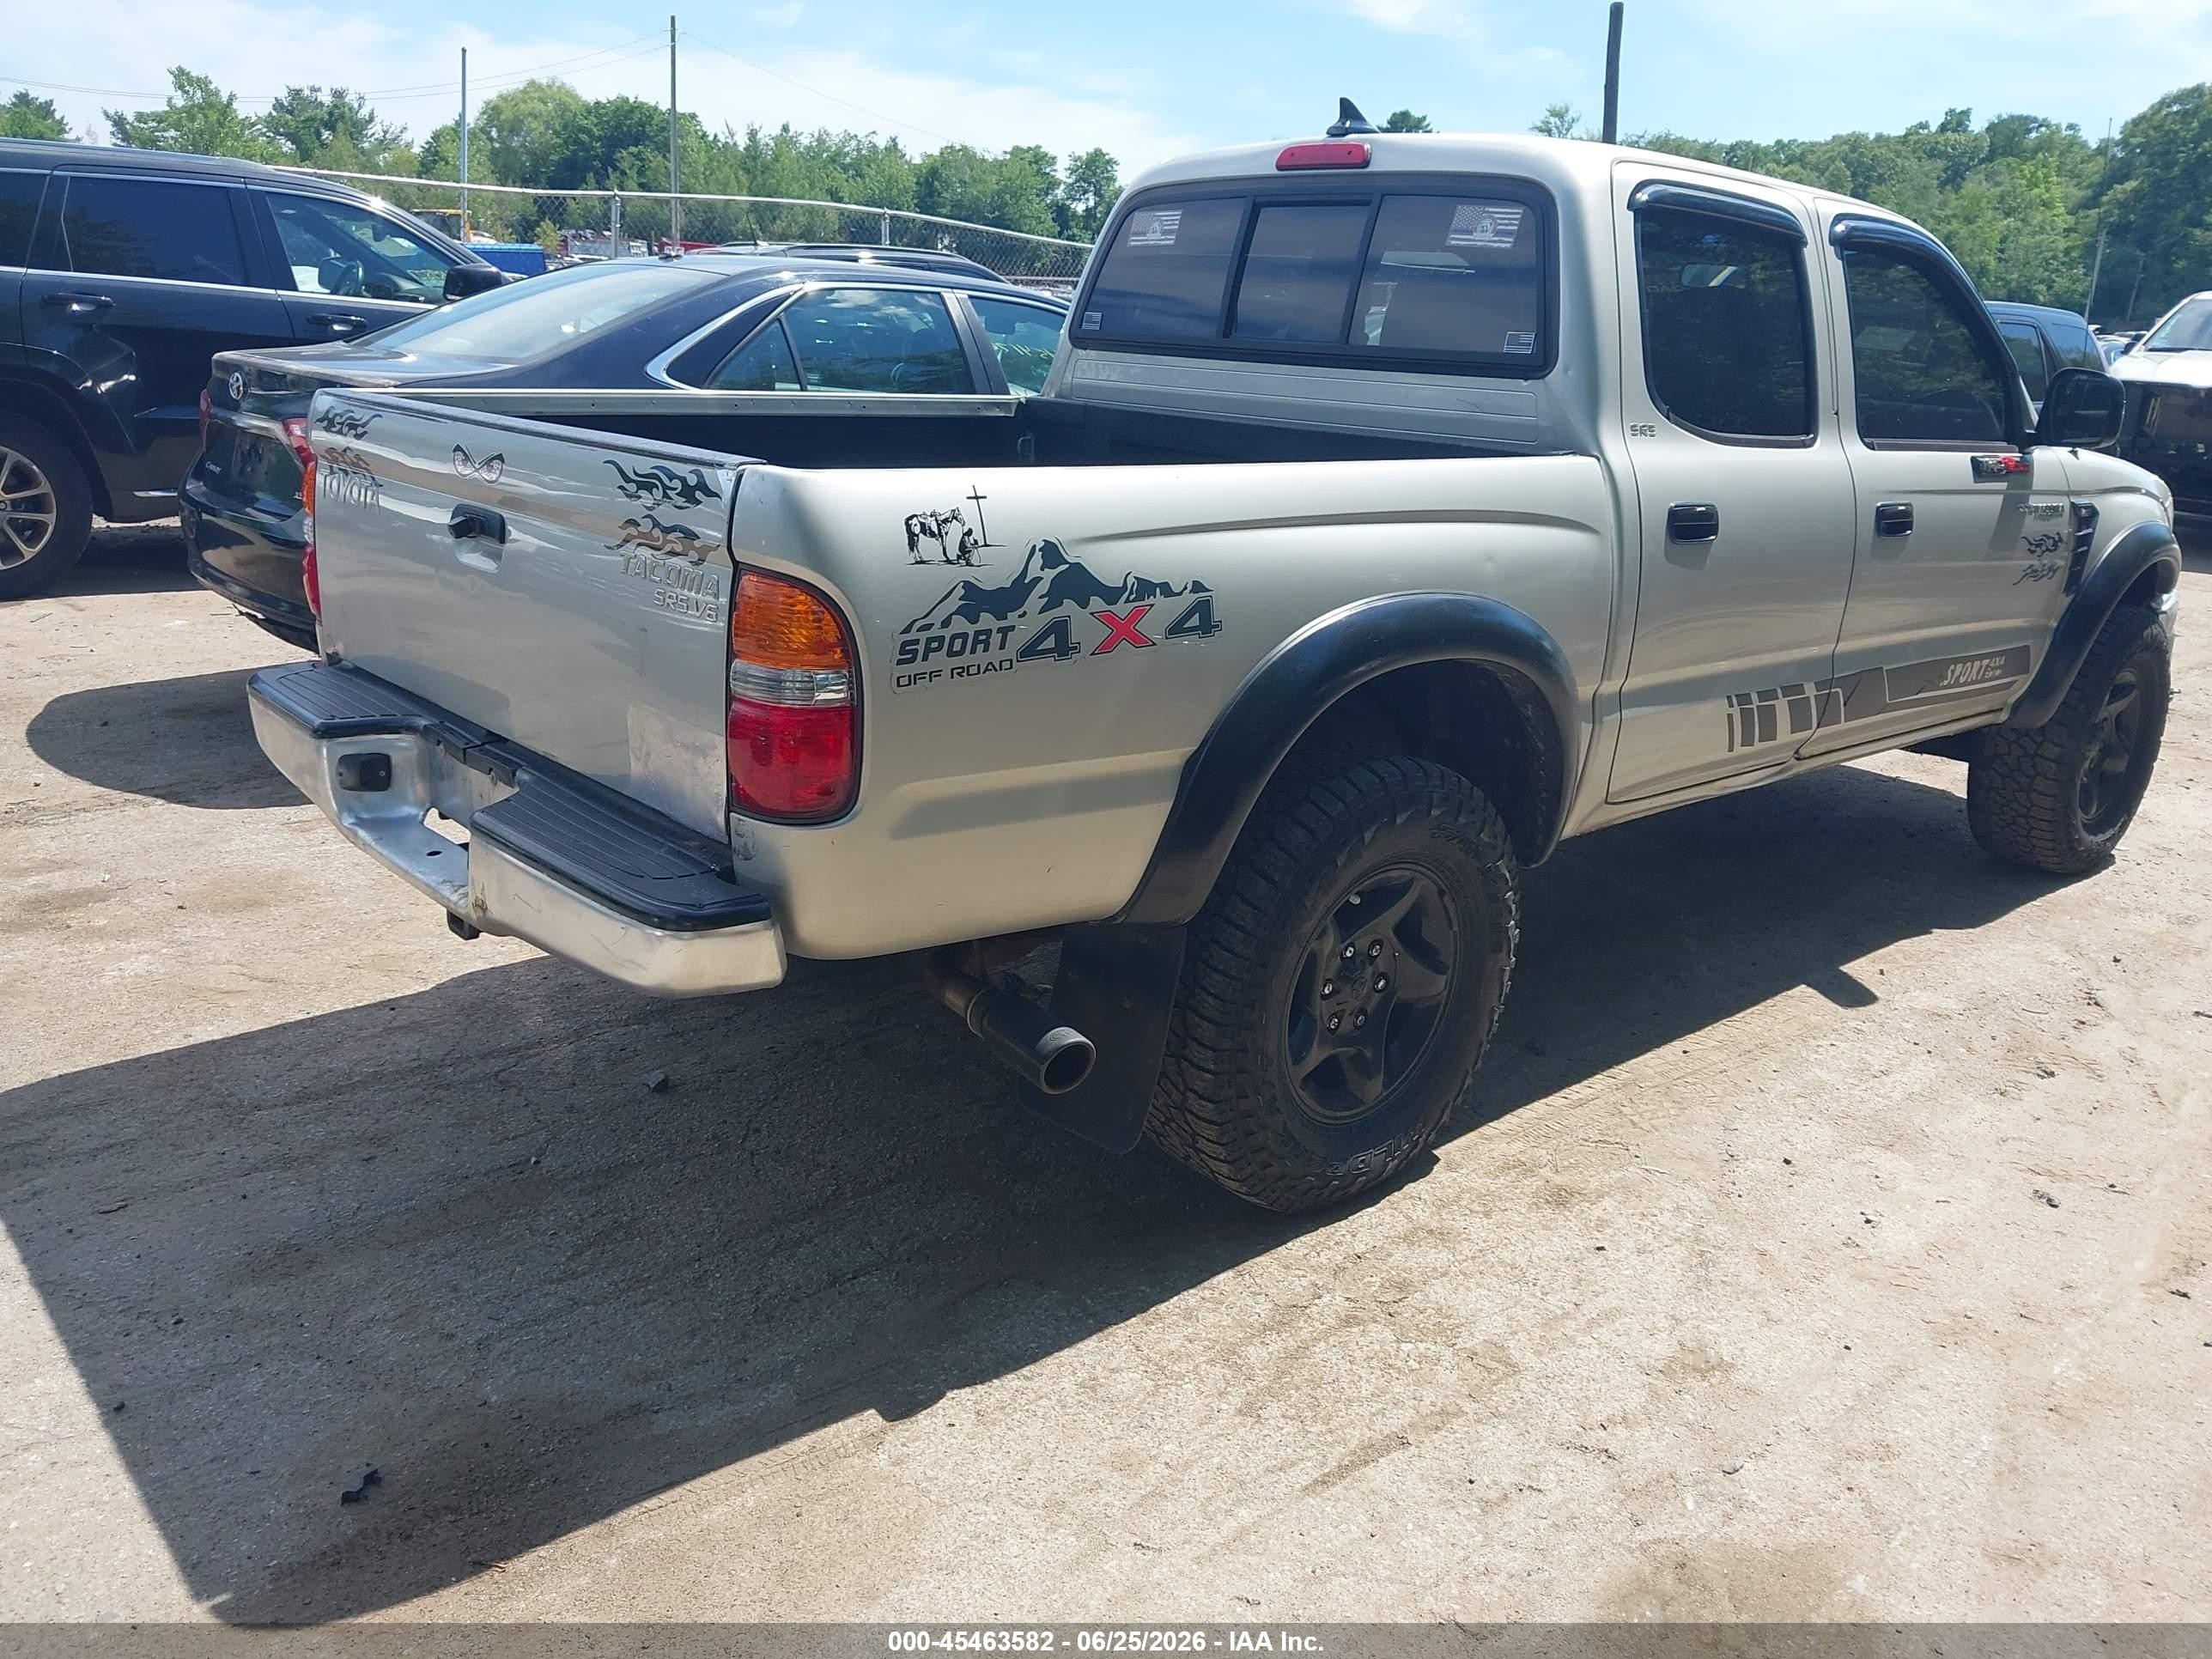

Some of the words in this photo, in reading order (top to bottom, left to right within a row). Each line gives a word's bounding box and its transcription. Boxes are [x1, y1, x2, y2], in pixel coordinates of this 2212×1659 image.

[320, 469, 381, 516] TOYOTA
[619, 550, 720, 601] TACOMA
[653, 587, 689, 614] SR5
[694, 598, 720, 623] V6
[896, 625, 1016, 665] SPORT
[896, 670, 945, 688] OFF
[950, 659, 1014, 680] ROAD
